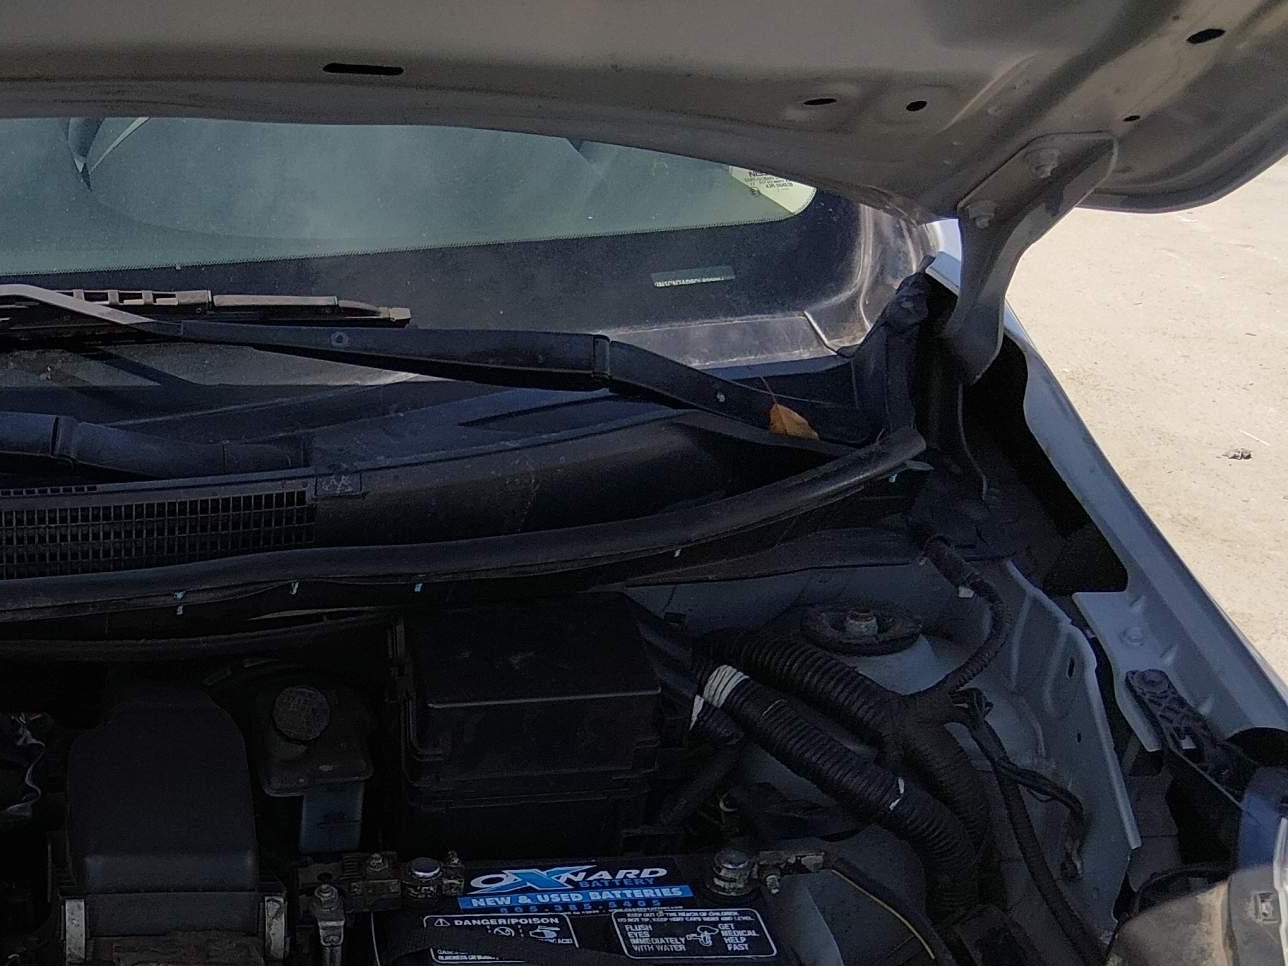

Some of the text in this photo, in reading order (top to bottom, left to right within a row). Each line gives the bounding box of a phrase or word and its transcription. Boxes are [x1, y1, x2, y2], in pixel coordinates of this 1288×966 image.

[468, 865, 668, 894] OXNARD
[579, 878, 655, 888] BATTERY
[471, 887, 683, 907] NEW & USED BATTERIES
[453, 917, 560, 926] DANGER/POISON
[629, 937, 685, 945] IMMEDIATELY
[723, 936, 746, 944] HELP
